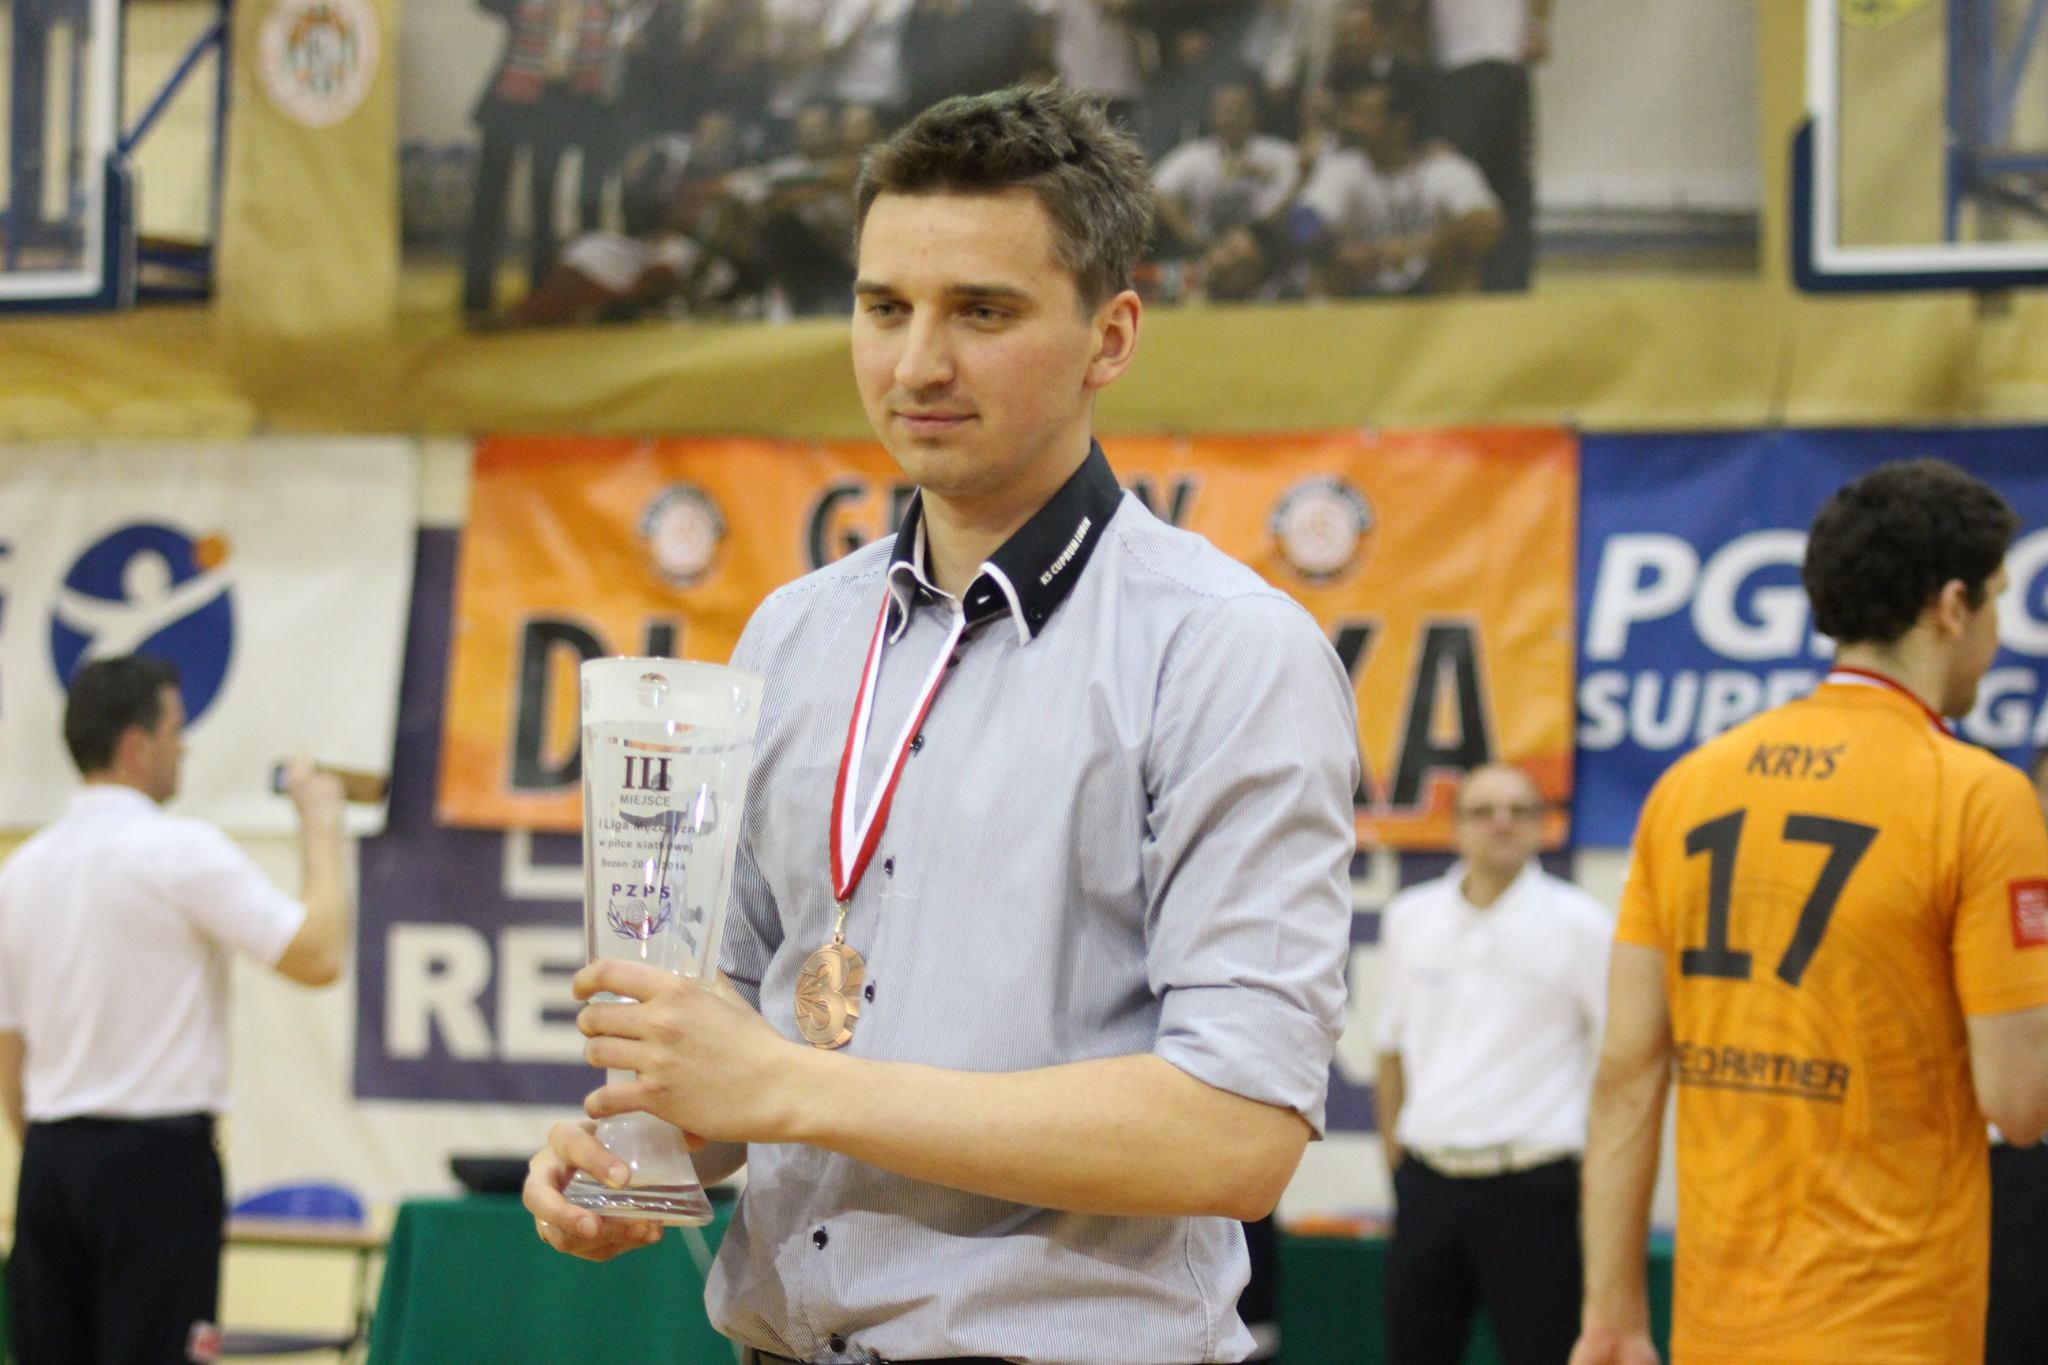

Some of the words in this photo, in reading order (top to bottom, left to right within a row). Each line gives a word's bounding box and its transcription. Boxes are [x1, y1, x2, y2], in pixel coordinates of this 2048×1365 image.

[1051, 538, 1080, 574] CUPRUM
[622, 755, 672, 791] III
[620, 794, 671, 807] MIEJSCE
[605, 819, 629, 833] Liga
[601, 858, 629, 869] Sezon
[1680, 808, 1880, 987] 17
